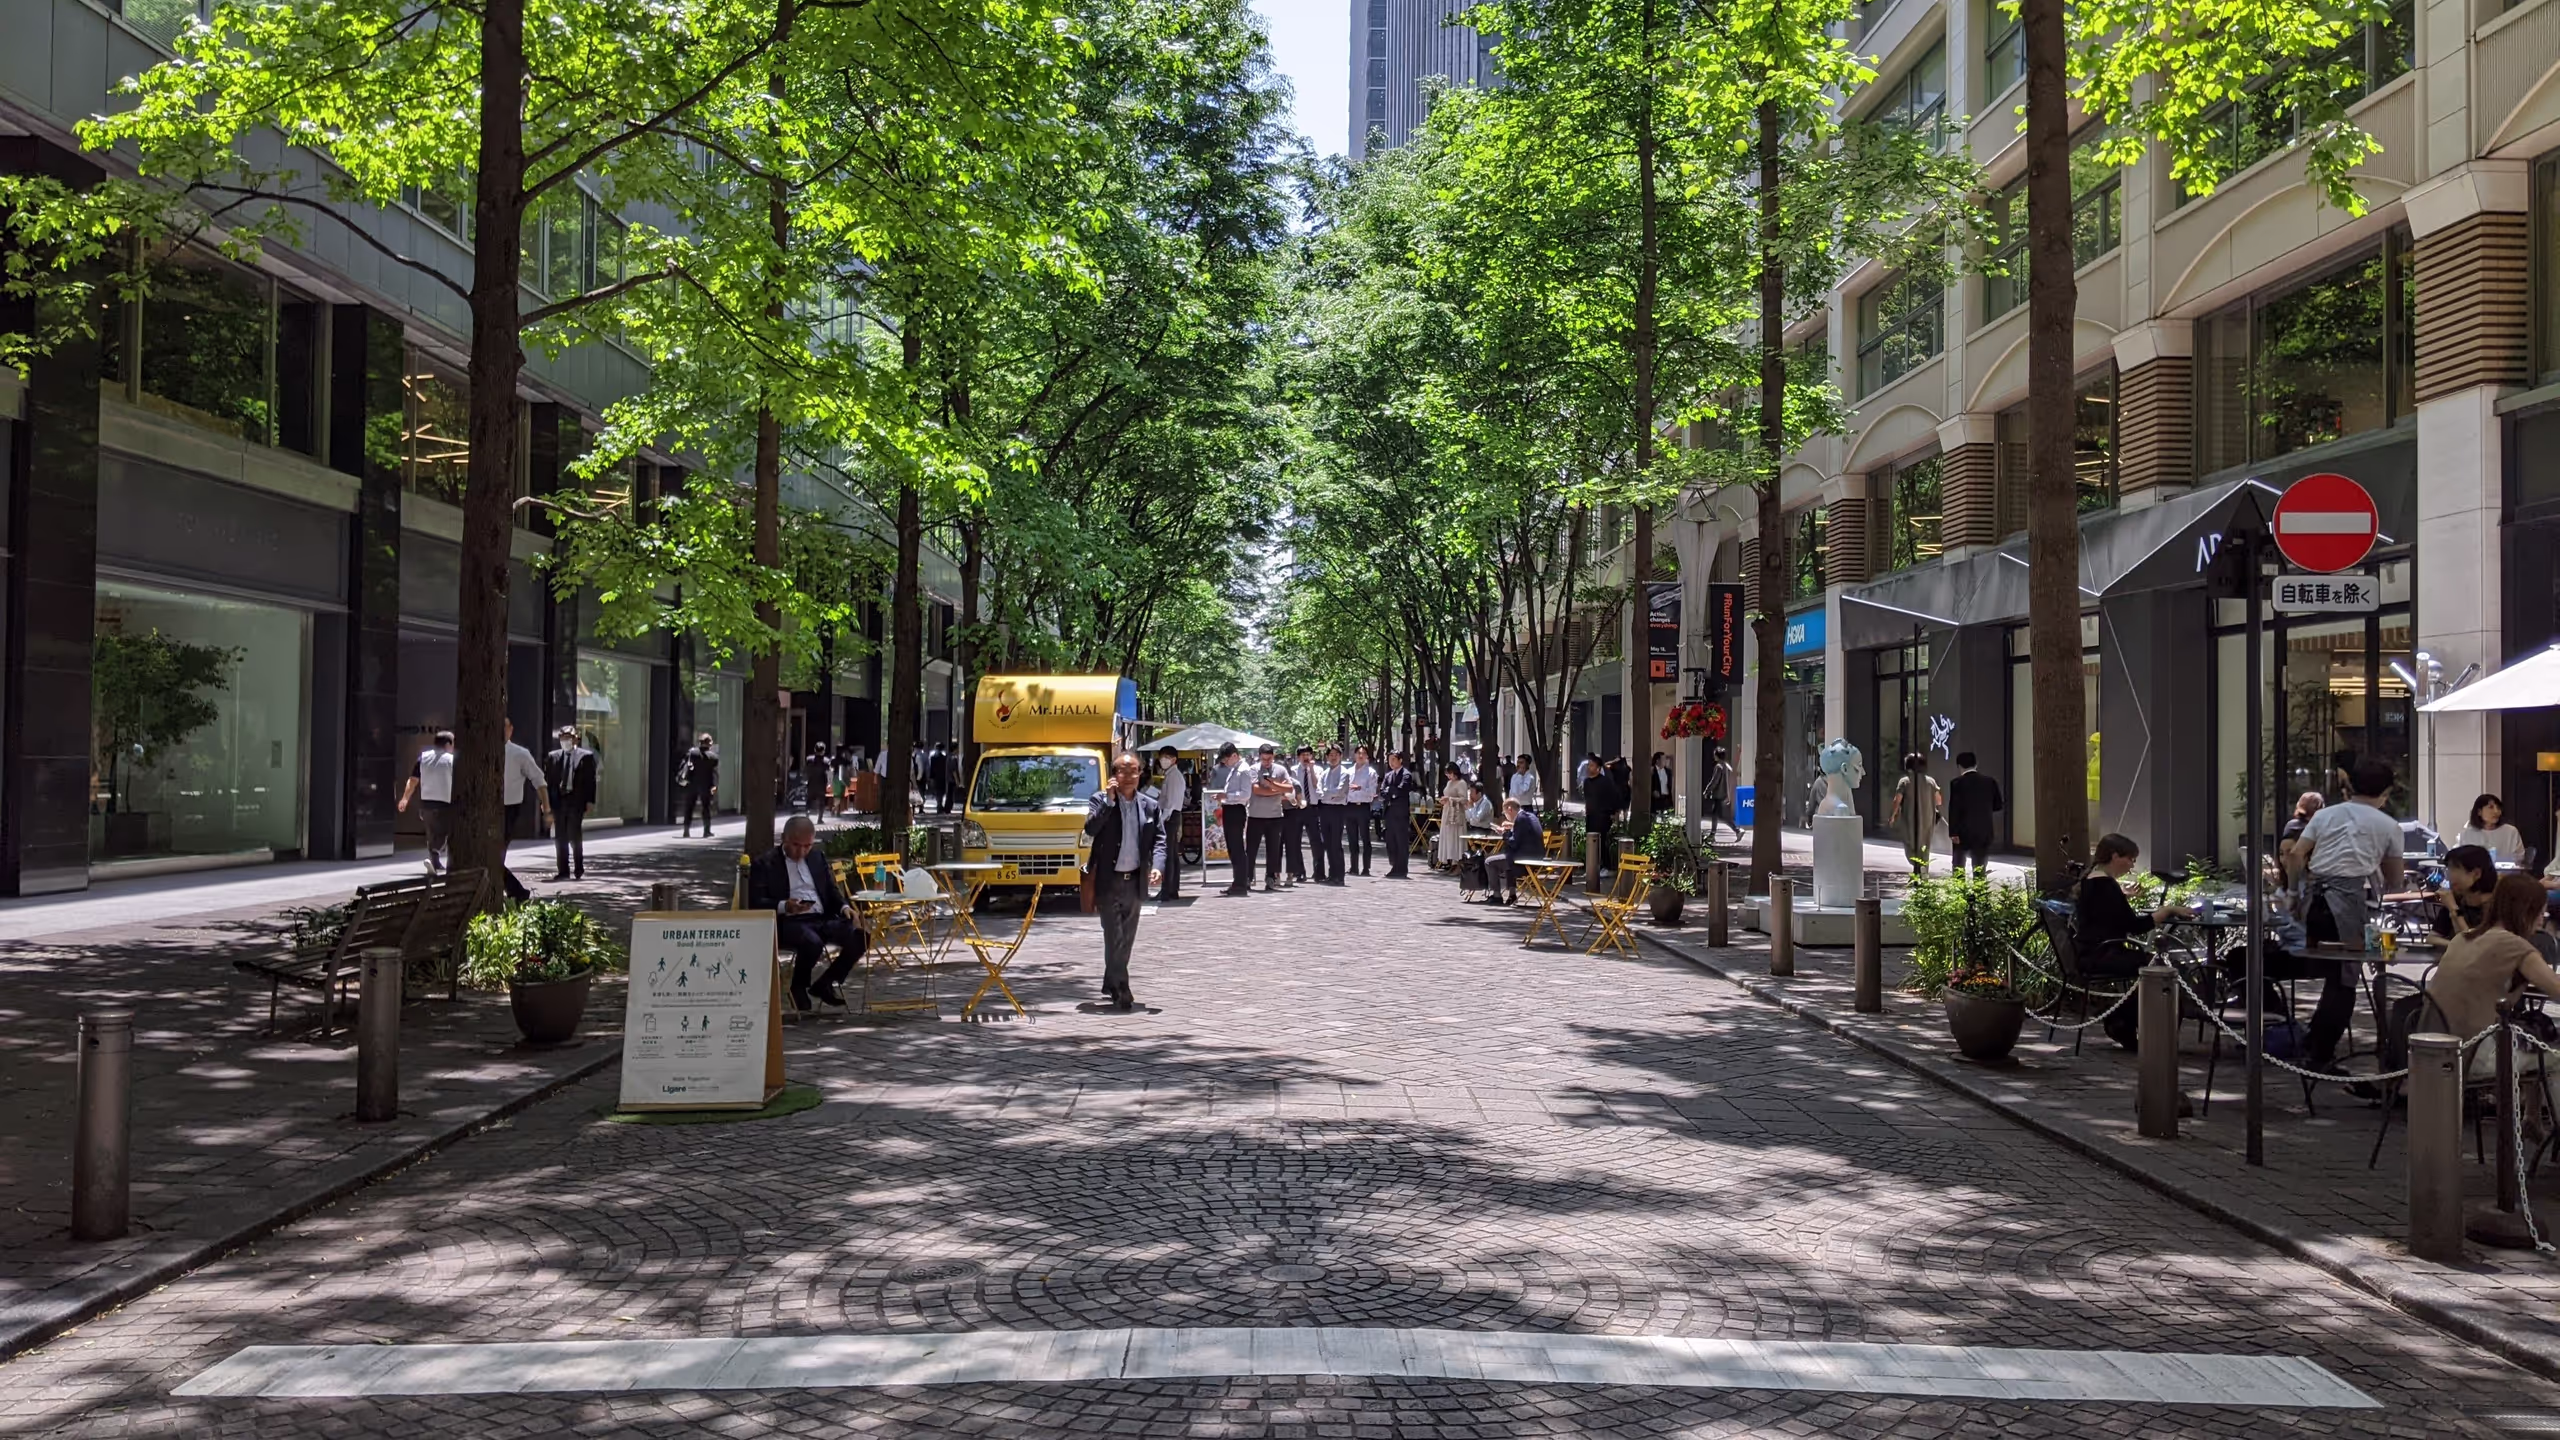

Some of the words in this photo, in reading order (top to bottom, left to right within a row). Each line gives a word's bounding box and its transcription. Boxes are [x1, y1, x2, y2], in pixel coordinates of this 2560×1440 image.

[2281, 583, 2371, 604] 自転車を除く
[1721, 593, 1733, 676] #RunForYourCity
[1786, 623, 1805, 646] HOKA
[662, 930, 696, 940] URBAN
[698, 929, 741, 939] TERRACE
[662, 1085, 687, 1095] Ligare
